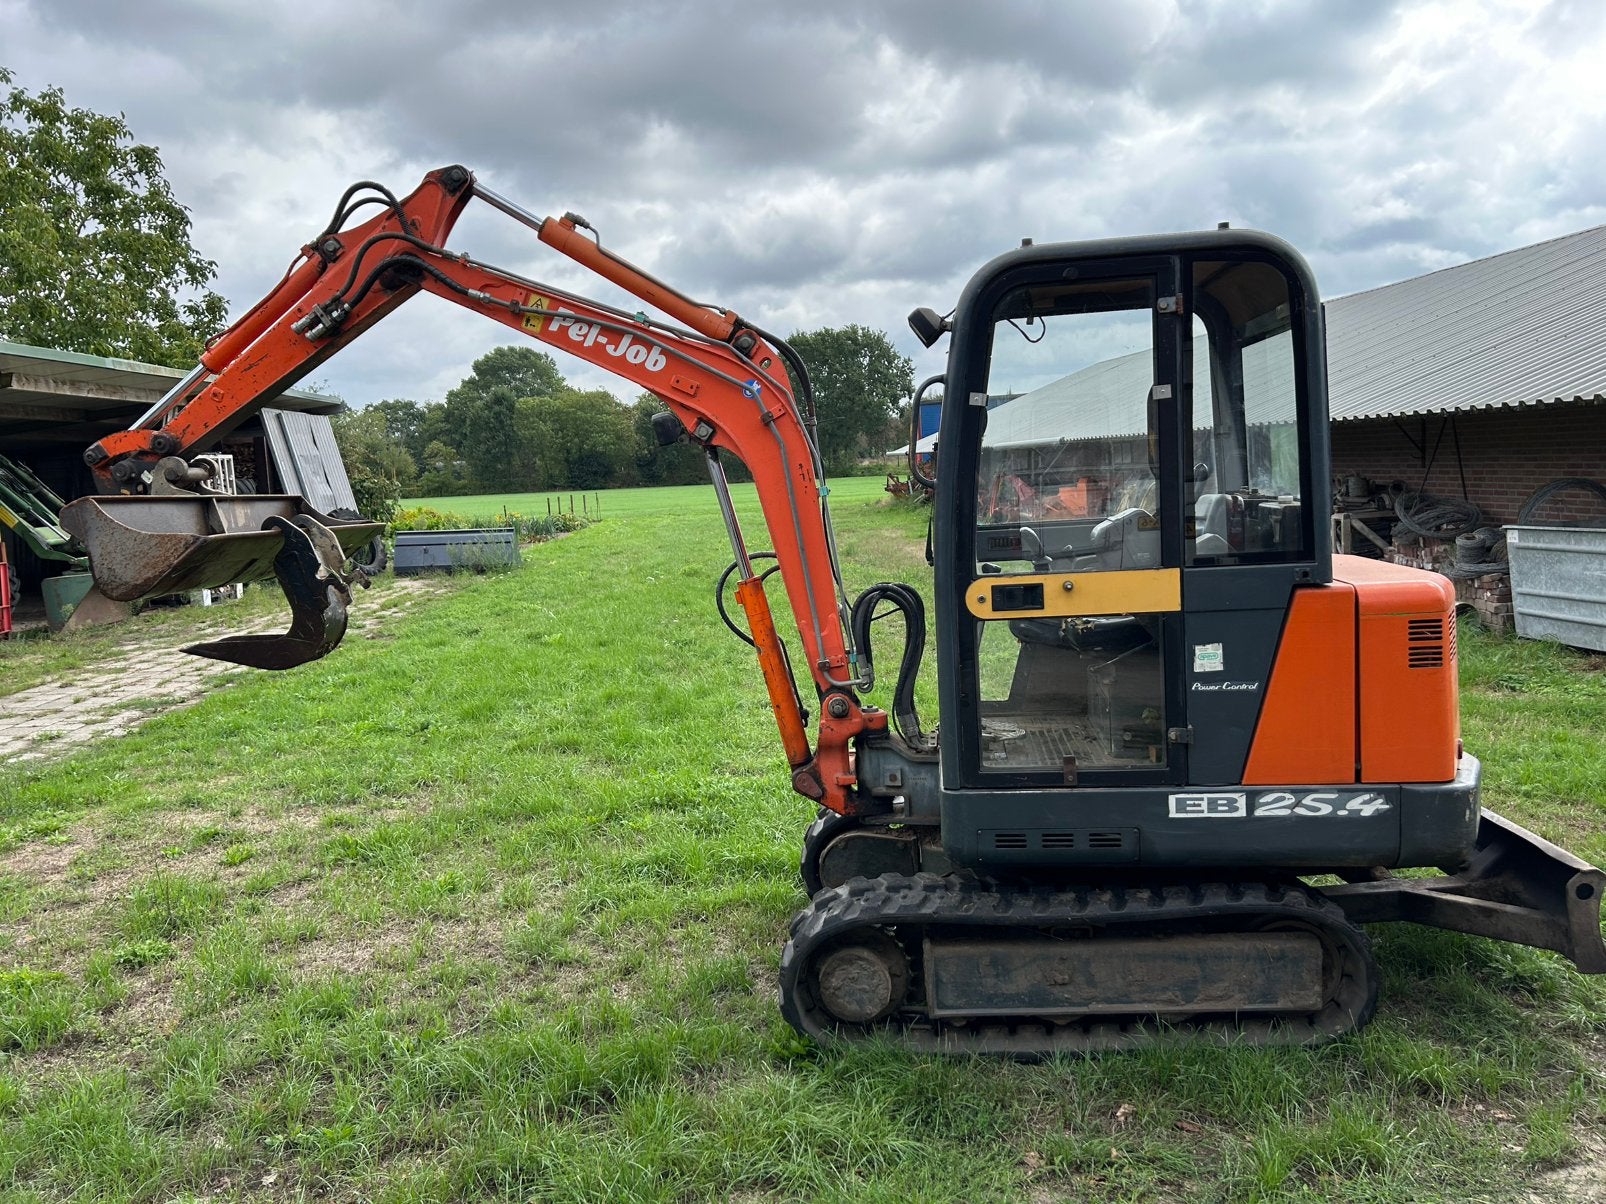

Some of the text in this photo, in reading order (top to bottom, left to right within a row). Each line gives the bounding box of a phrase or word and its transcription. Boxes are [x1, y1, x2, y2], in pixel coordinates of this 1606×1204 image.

[548, 307, 667, 372] Pel-Job
[1191, 681, 1259, 690] Power Control
[1173, 792, 1390, 817] EB 25.4
